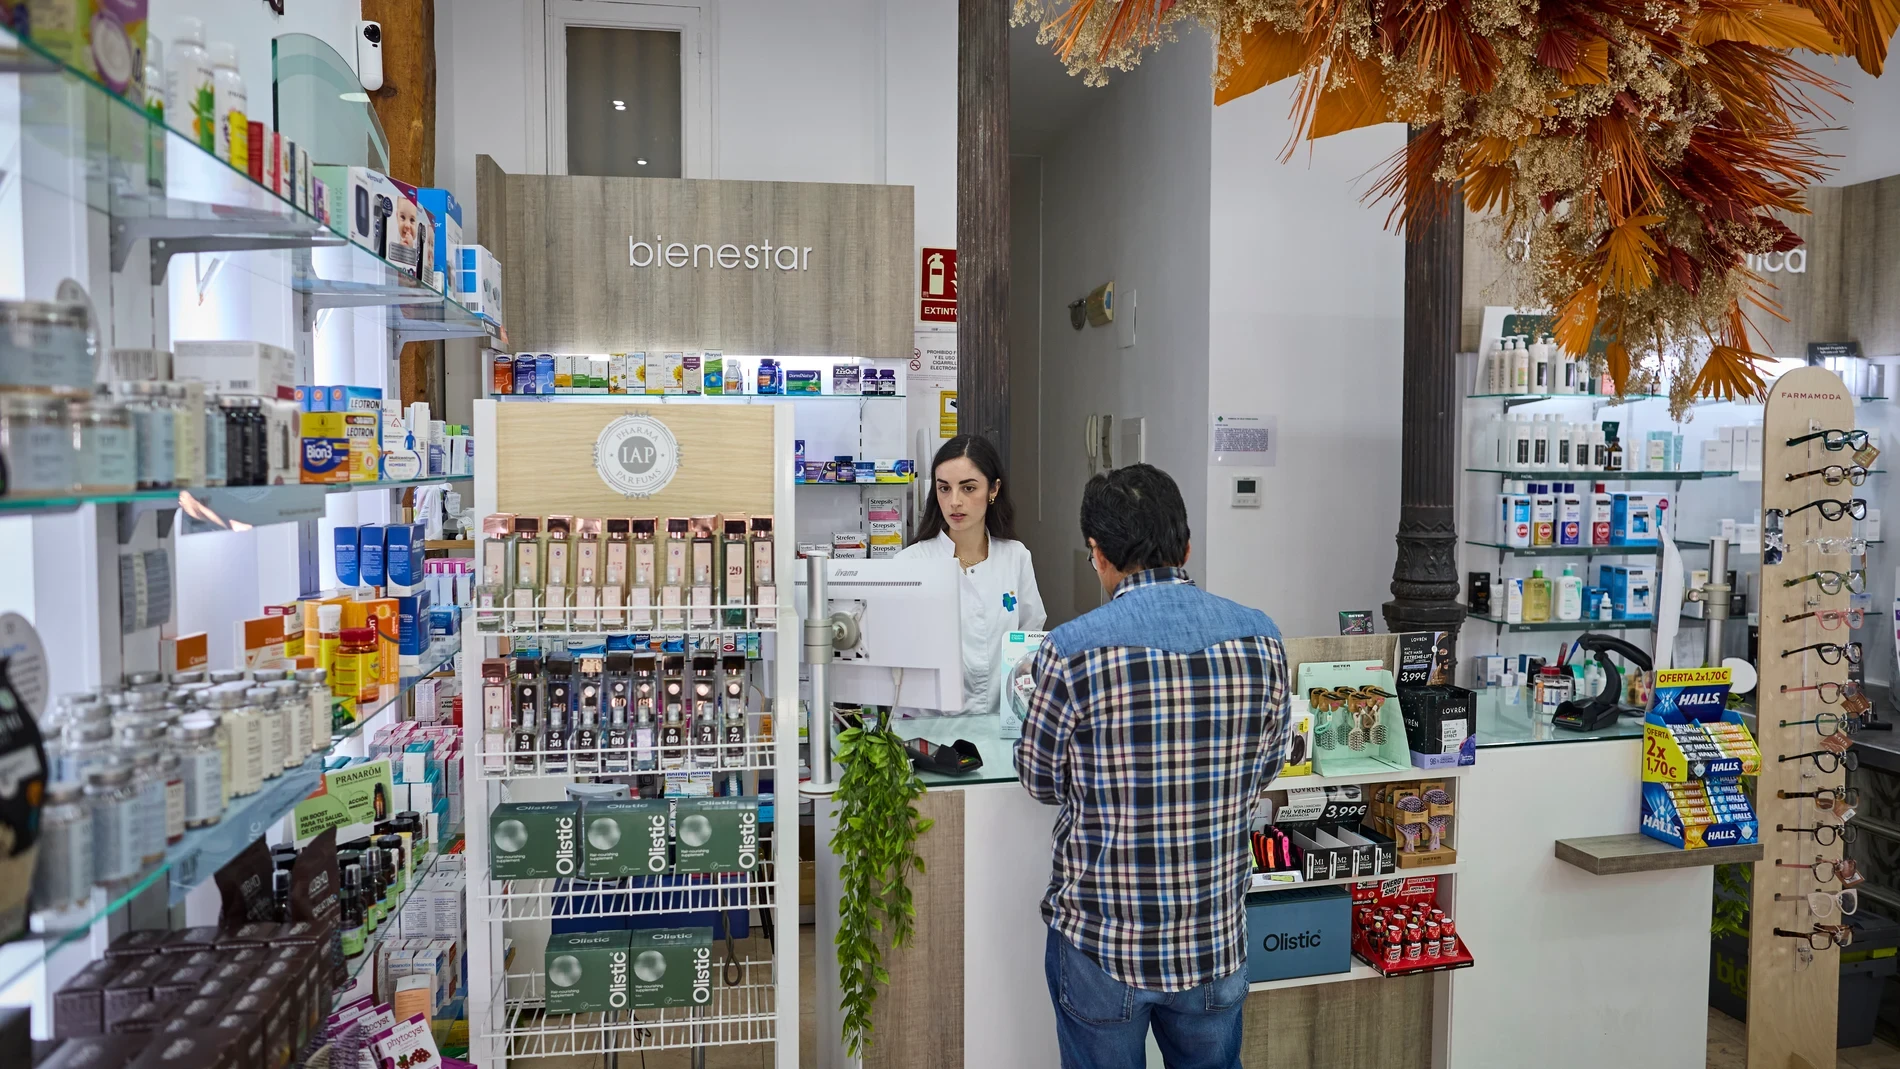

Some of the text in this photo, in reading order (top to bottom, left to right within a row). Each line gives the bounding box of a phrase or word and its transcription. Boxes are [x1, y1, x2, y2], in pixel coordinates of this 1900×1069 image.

[629, 234, 812, 271] bienestar
[1782, 392, 1841, 400] FARMAMODA
[350, 399, 380, 409] LEOTRON
[346, 427, 374, 437] LEOTRON
[616, 427, 659, 442] PHARMA
[306, 443, 333, 459] Bion3
[622, 446, 654, 463] IAP
[616, 468, 661, 484] PARFUMS
[729, 566, 742, 576] 29
[1401, 671, 1427, 682] 3,99€
[1659, 671, 1728, 683] OFERTA 2x1,70€
[1678, 692, 1720, 706] HALLS
[702, 733, 712, 742] 71
[729, 733, 740, 742] 72
[1646, 728, 1670, 740] OFERTA
[1646, 736, 1667, 760] 2x
[1646, 757, 1677, 778] 1,70€
[1711, 762, 1739, 772] HALLS
[348, 794, 369, 806] ACCIÓN
[300, 810, 328, 821] UN BOOST
[1325, 805, 1367, 819] 3,99€
[300, 820, 317, 829] PARA
[310, 823, 326, 833] OTRA
[1643, 815, 1682, 839] HALLS
[738, 812, 756, 869] Olistic
[1708, 830, 1736, 840] HALLS
[556, 817, 574, 875] Olistic
[648, 814, 666, 872] Olistic
[1382, 878, 1404, 889] ENERGY
[1263, 930, 1321, 952] Olistic
[609, 951, 627, 1008] Olistic
[693, 947, 710, 1003] Olistic
[386, 1025, 424, 1049] phytocyst
